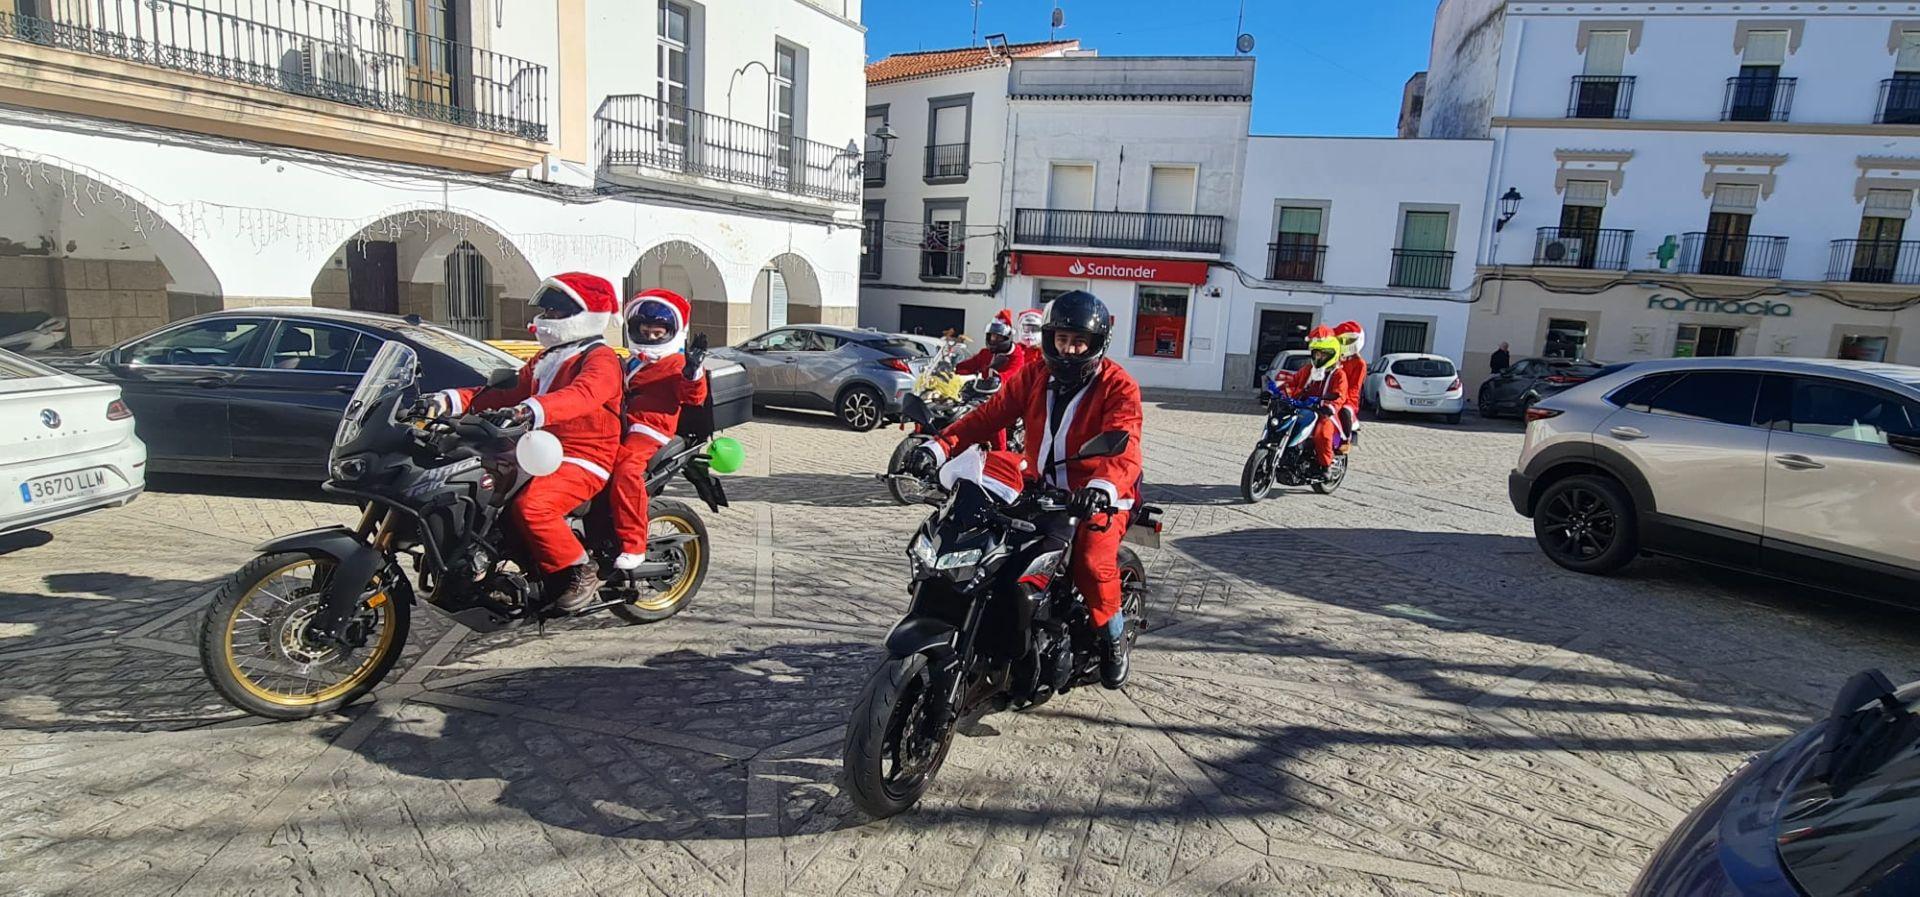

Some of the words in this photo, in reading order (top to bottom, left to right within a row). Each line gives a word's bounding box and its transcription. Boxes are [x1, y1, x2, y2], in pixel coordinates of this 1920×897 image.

[1087, 263, 1157, 278] Santander
[1648, 294, 1792, 317] farmacia
[33, 477, 74, 498] 3670
[77, 470, 105, 490] LLM
